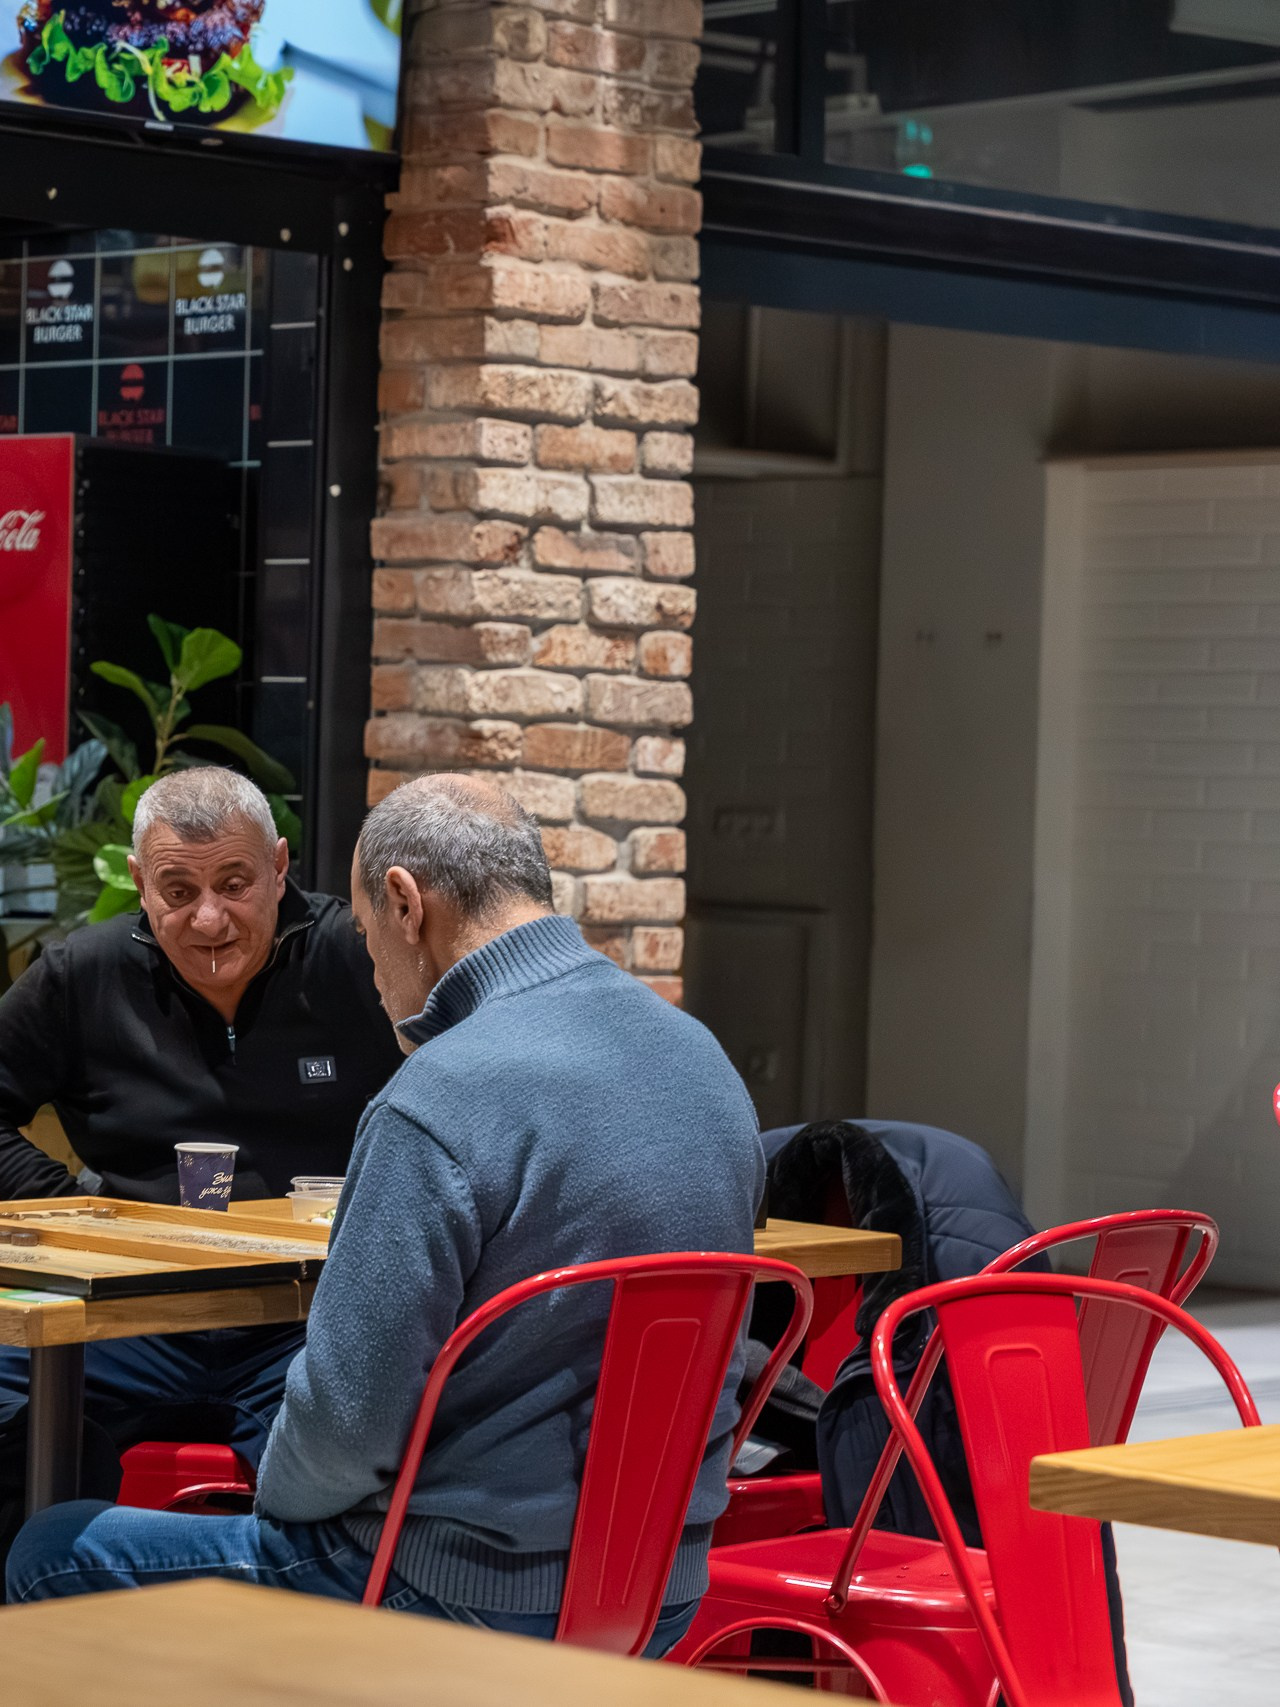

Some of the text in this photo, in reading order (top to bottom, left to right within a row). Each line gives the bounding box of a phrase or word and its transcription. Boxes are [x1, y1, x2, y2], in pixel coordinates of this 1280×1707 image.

[26, 303, 94, 325] BLACK STAR
[176, 293, 247, 315] BLACK STAR
[34, 323, 83, 344] BURGER
[184, 313, 236, 334] BURGER
